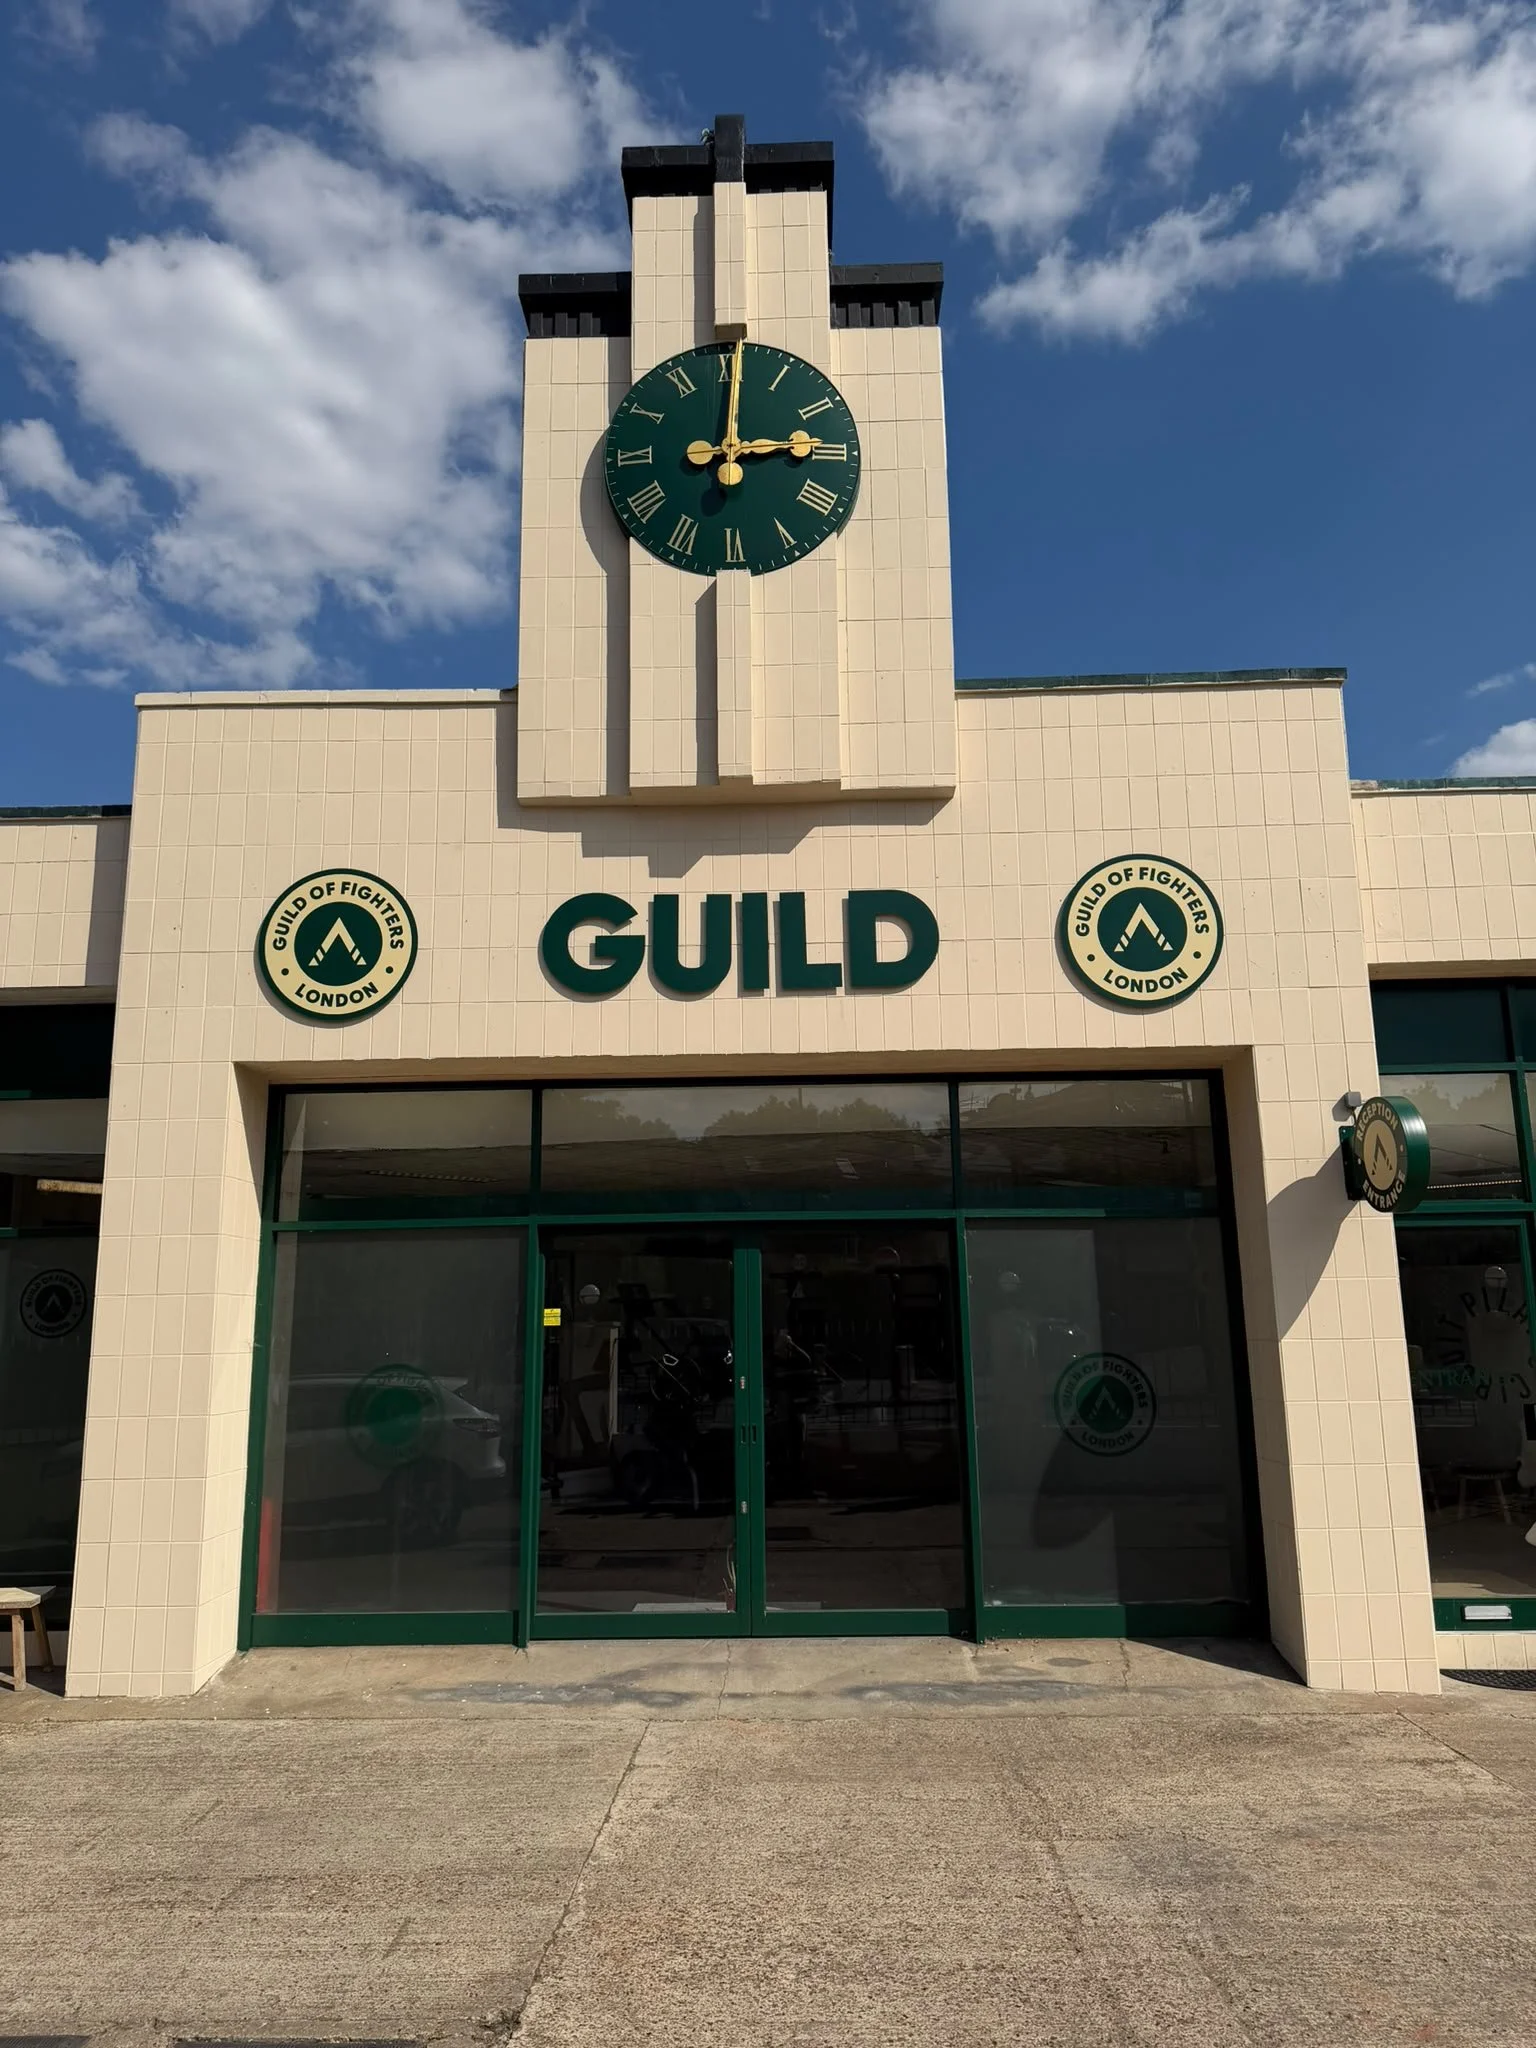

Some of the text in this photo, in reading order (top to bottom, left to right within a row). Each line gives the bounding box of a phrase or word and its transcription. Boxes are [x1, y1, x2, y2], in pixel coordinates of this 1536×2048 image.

[665, 366, 697, 398] XI
[769, 365, 790, 391] I
[629, 403, 665, 424] X
[798, 397, 834, 420] II
[618, 446, 652, 467] IX
[812, 443, 847, 462] III
[627, 480, 667, 524] VIII
[796, 478, 838, 516] IIII
[667, 513, 699, 556] VII
[724, 528, 746, 563] VI
[773, 517, 797, 549] V
[273, 881, 405, 951] GUILD OF FIGHTERS
[1075, 867, 1210, 937] GUILD OF FIGHTERS
[542, 889, 940, 994] GUILD
[294, 981, 379, 1007] LONDON
[1103, 967, 1189, 993] LONDON
[1356, 1102, 1399, 1141] RECEPTION
[1362, 1169, 1406, 1209] ENTRANCE
[1102, 1361, 1148, 1408] FIGHTERS
[1082, 1431, 1135, 1449] LONDON
